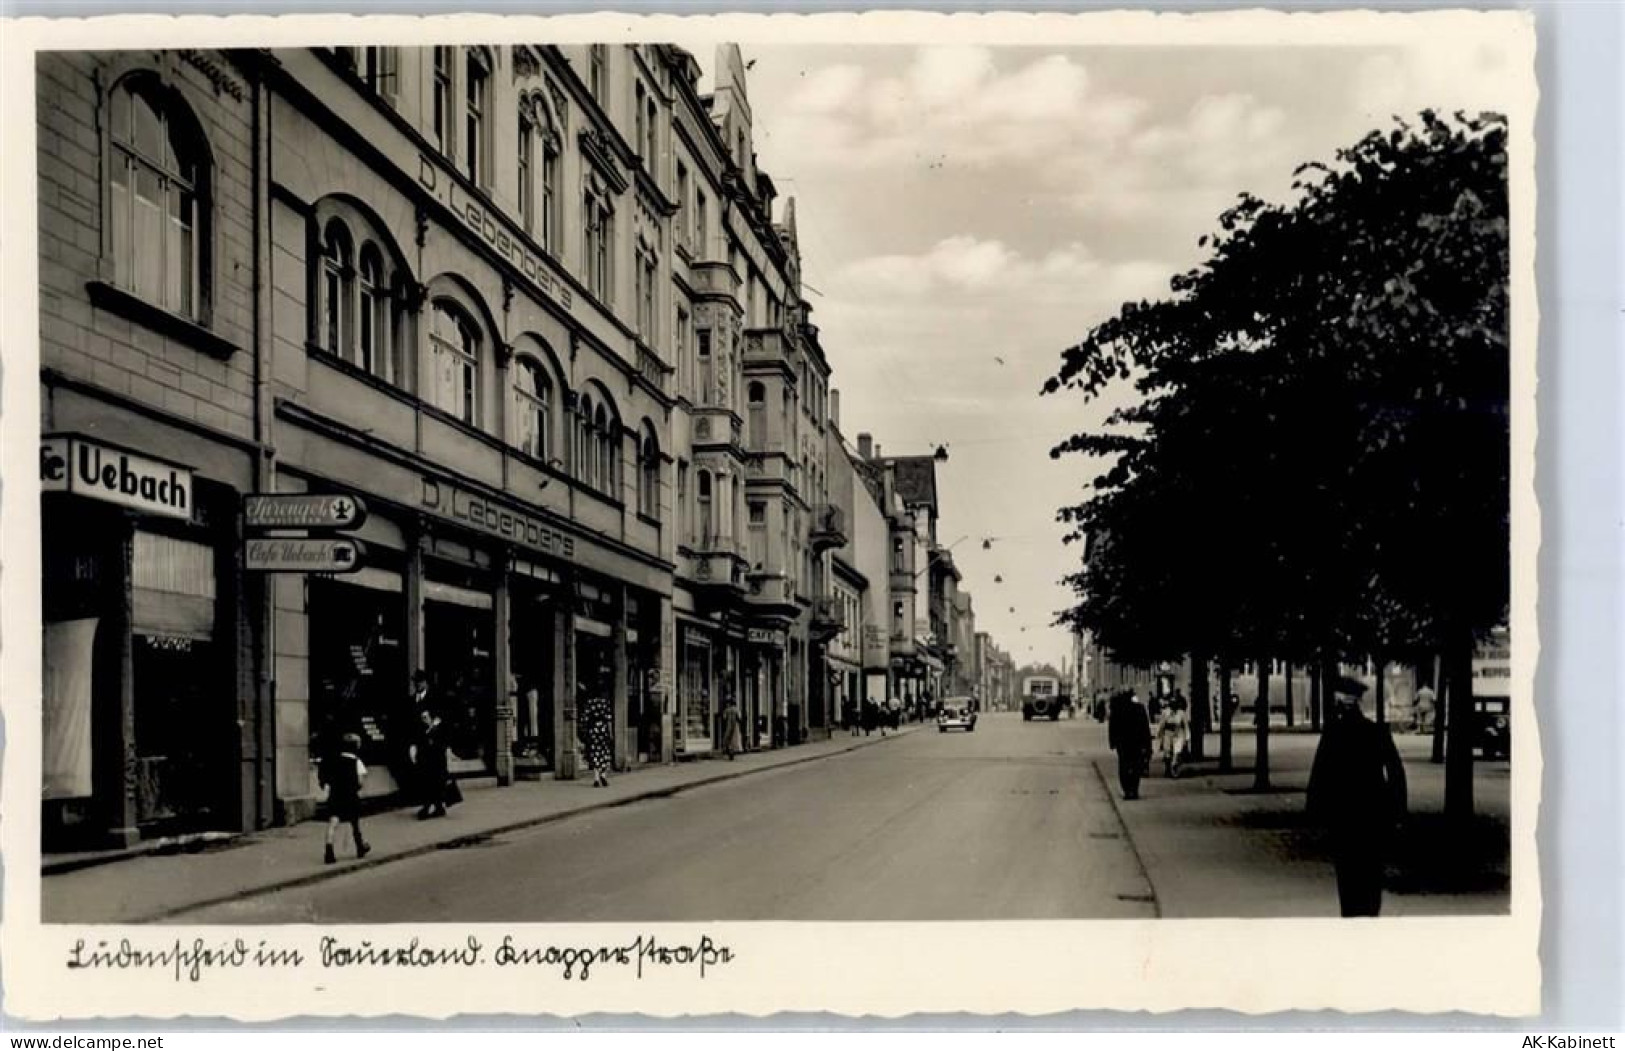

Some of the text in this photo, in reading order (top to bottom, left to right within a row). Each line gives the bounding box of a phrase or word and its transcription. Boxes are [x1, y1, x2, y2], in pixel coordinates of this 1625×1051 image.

[79, 444, 185, 508] Uebach
[67, 937, 249, 982] Lüdenscheid
[254, 940, 303, 967] im
[494, 934, 735, 981] Knapperstraße
